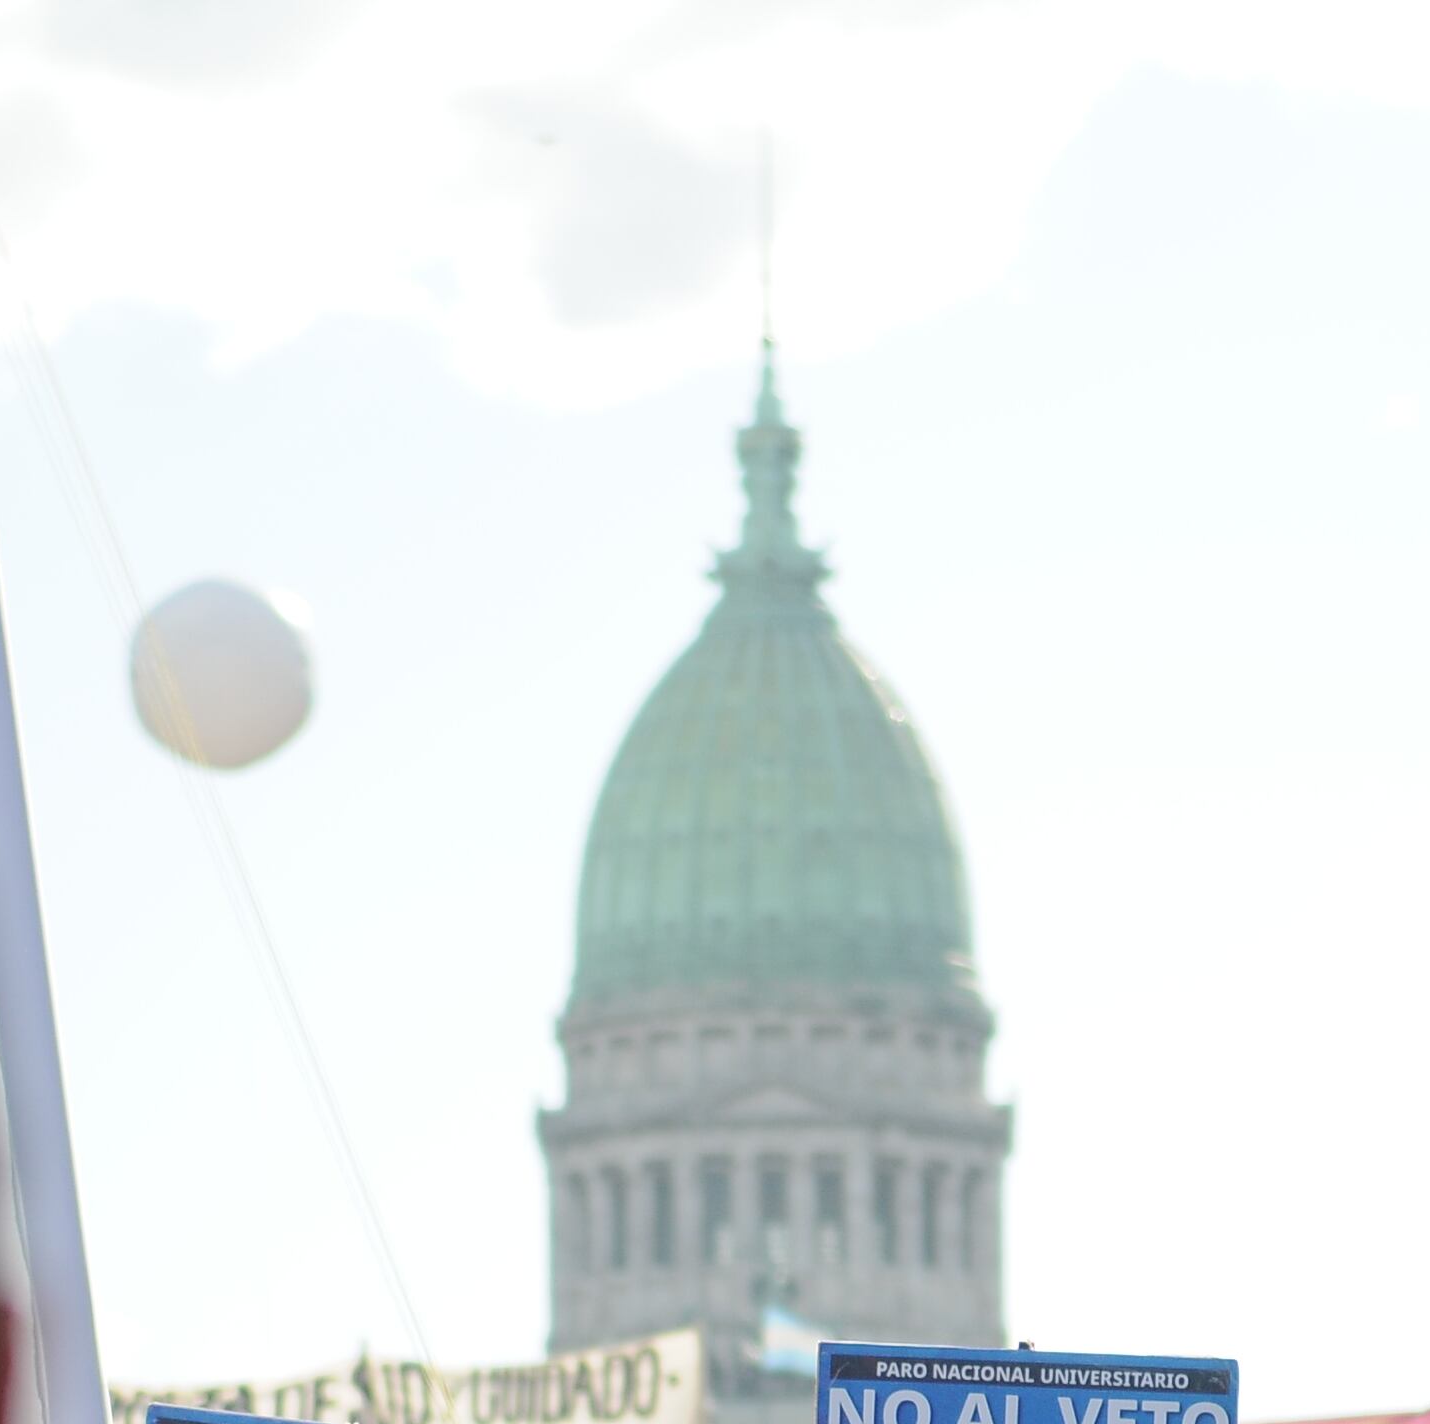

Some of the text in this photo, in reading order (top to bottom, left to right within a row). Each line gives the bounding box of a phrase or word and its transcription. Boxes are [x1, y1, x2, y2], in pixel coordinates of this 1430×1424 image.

[876, 1361, 1189, 1389] PARO NACIONAL UNIVERSITARIO
